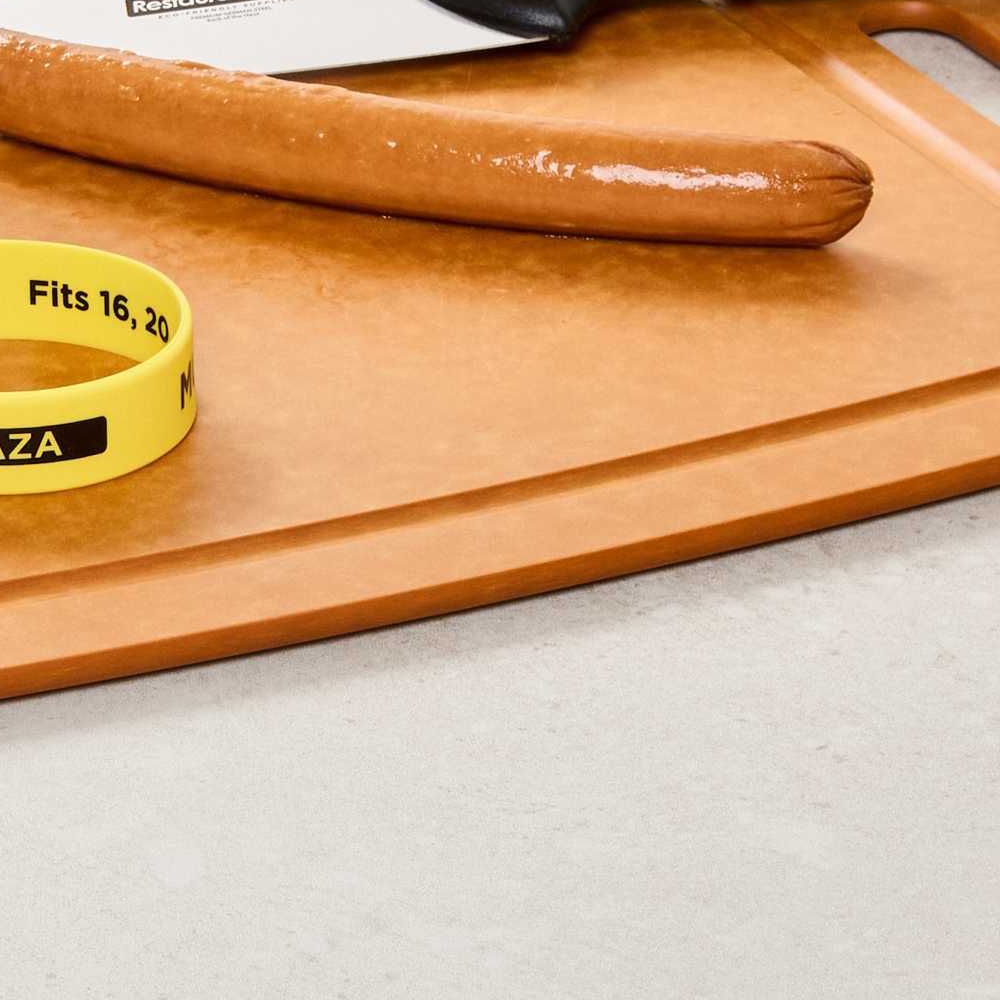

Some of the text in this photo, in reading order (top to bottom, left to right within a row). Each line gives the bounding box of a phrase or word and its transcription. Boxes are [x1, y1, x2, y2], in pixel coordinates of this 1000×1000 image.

[29, 279, 169, 343] Fits 16, 20
